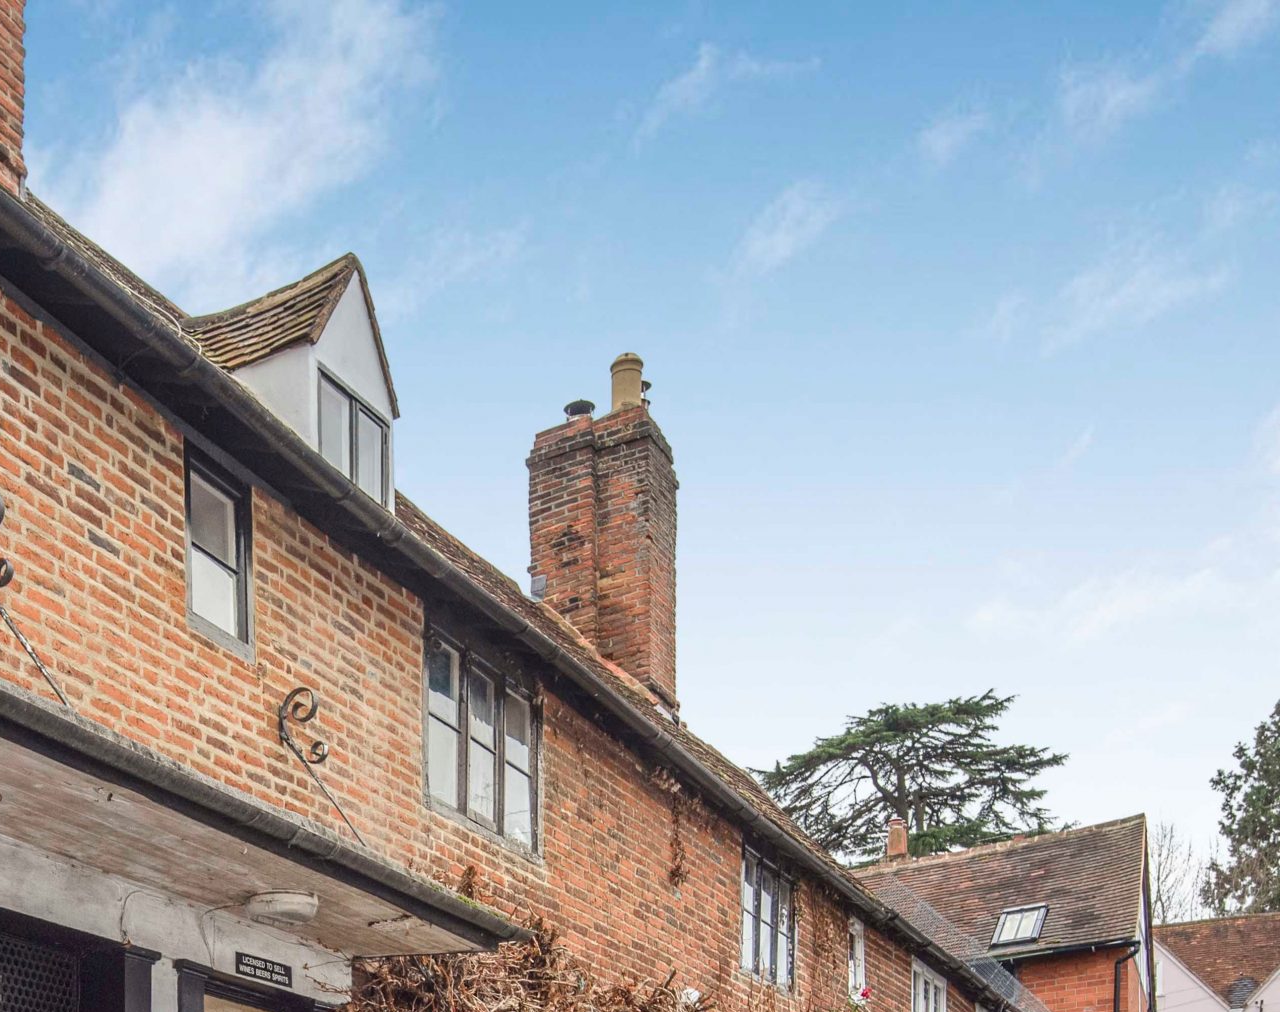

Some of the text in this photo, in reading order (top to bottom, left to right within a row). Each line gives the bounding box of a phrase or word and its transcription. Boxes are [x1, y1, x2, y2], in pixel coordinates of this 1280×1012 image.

[239, 964, 289, 985] WINES BEERS SPIRITS
[242, 955, 285, 974] LICENSED TO SELL
